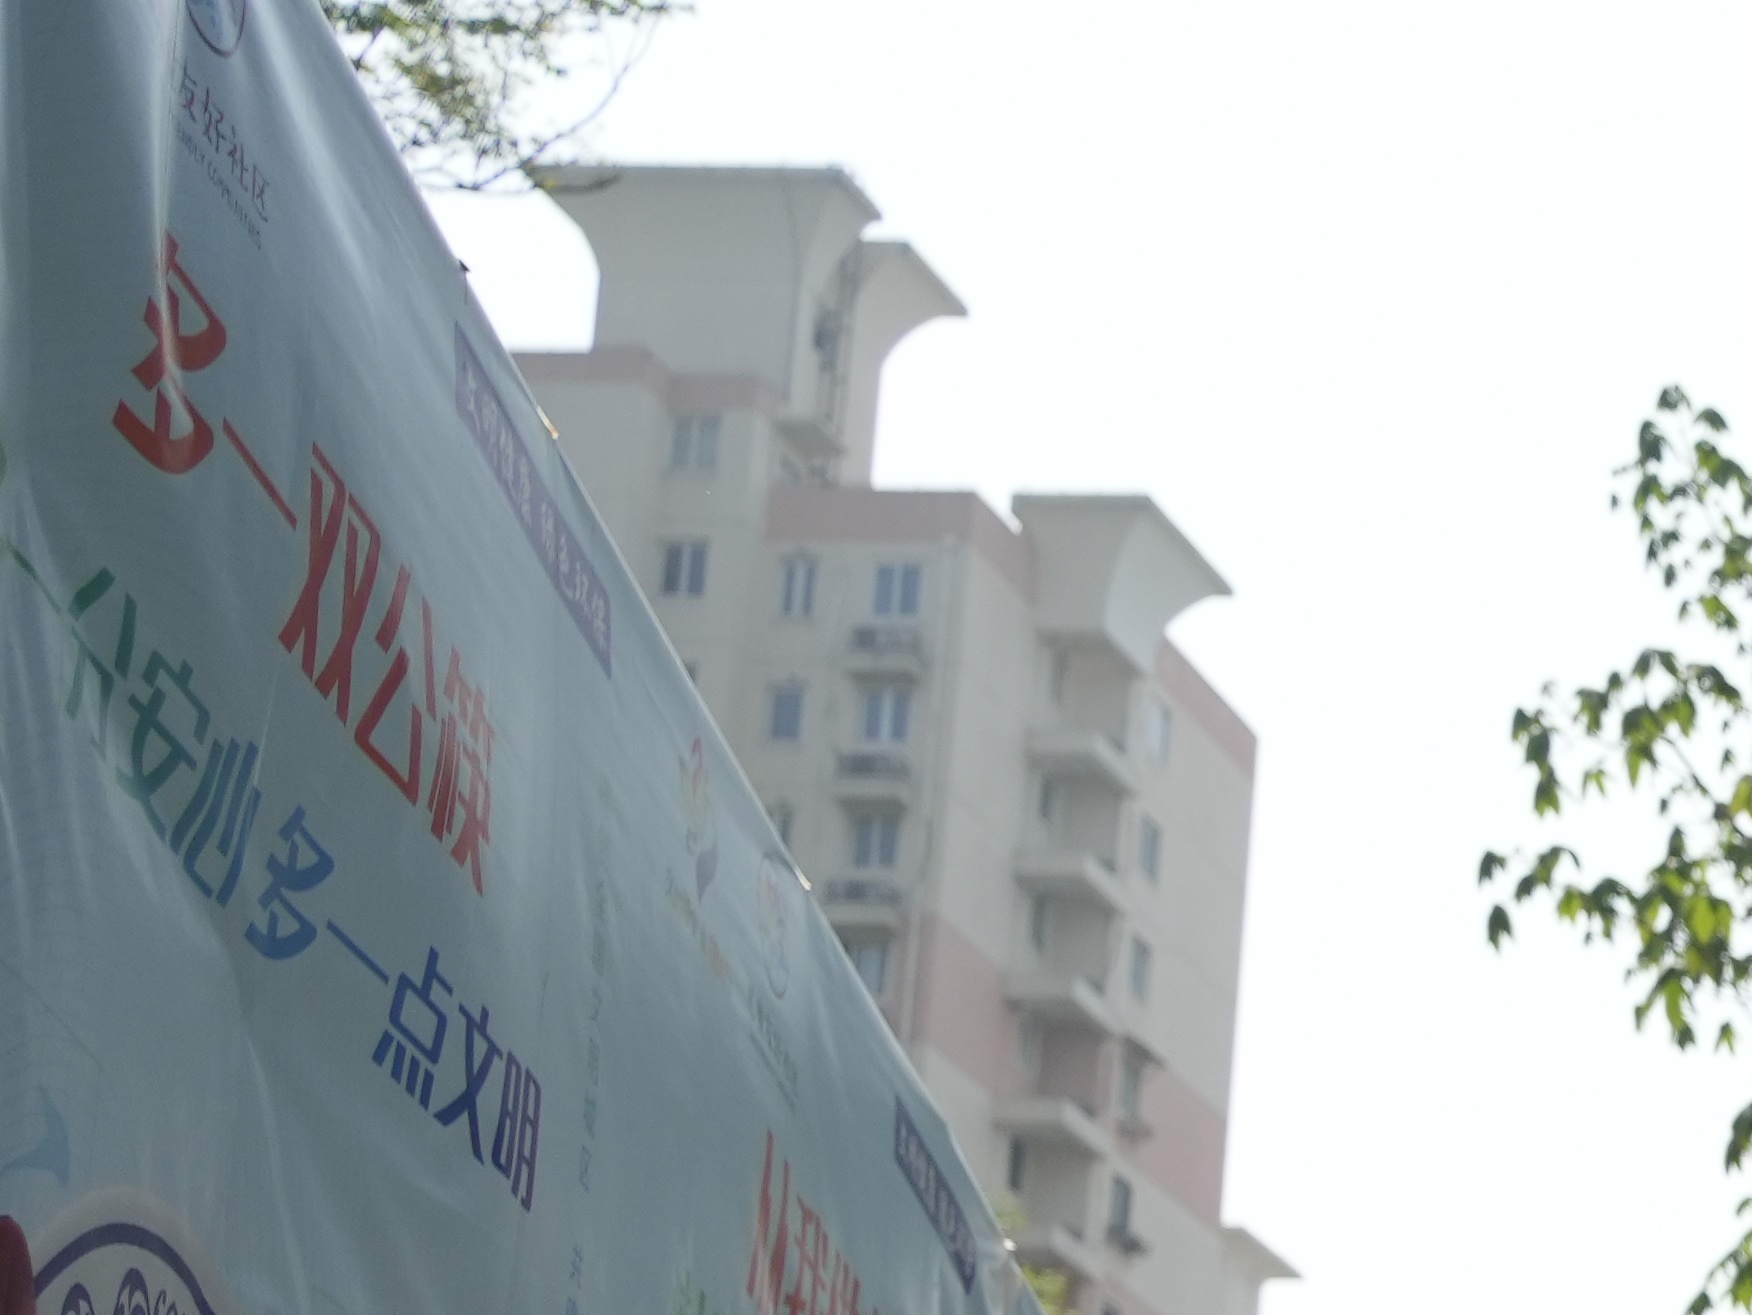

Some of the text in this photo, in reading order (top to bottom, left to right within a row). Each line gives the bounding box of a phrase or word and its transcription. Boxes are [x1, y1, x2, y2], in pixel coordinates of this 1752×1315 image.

[111, 229, 494, 898] 多一双公筷
